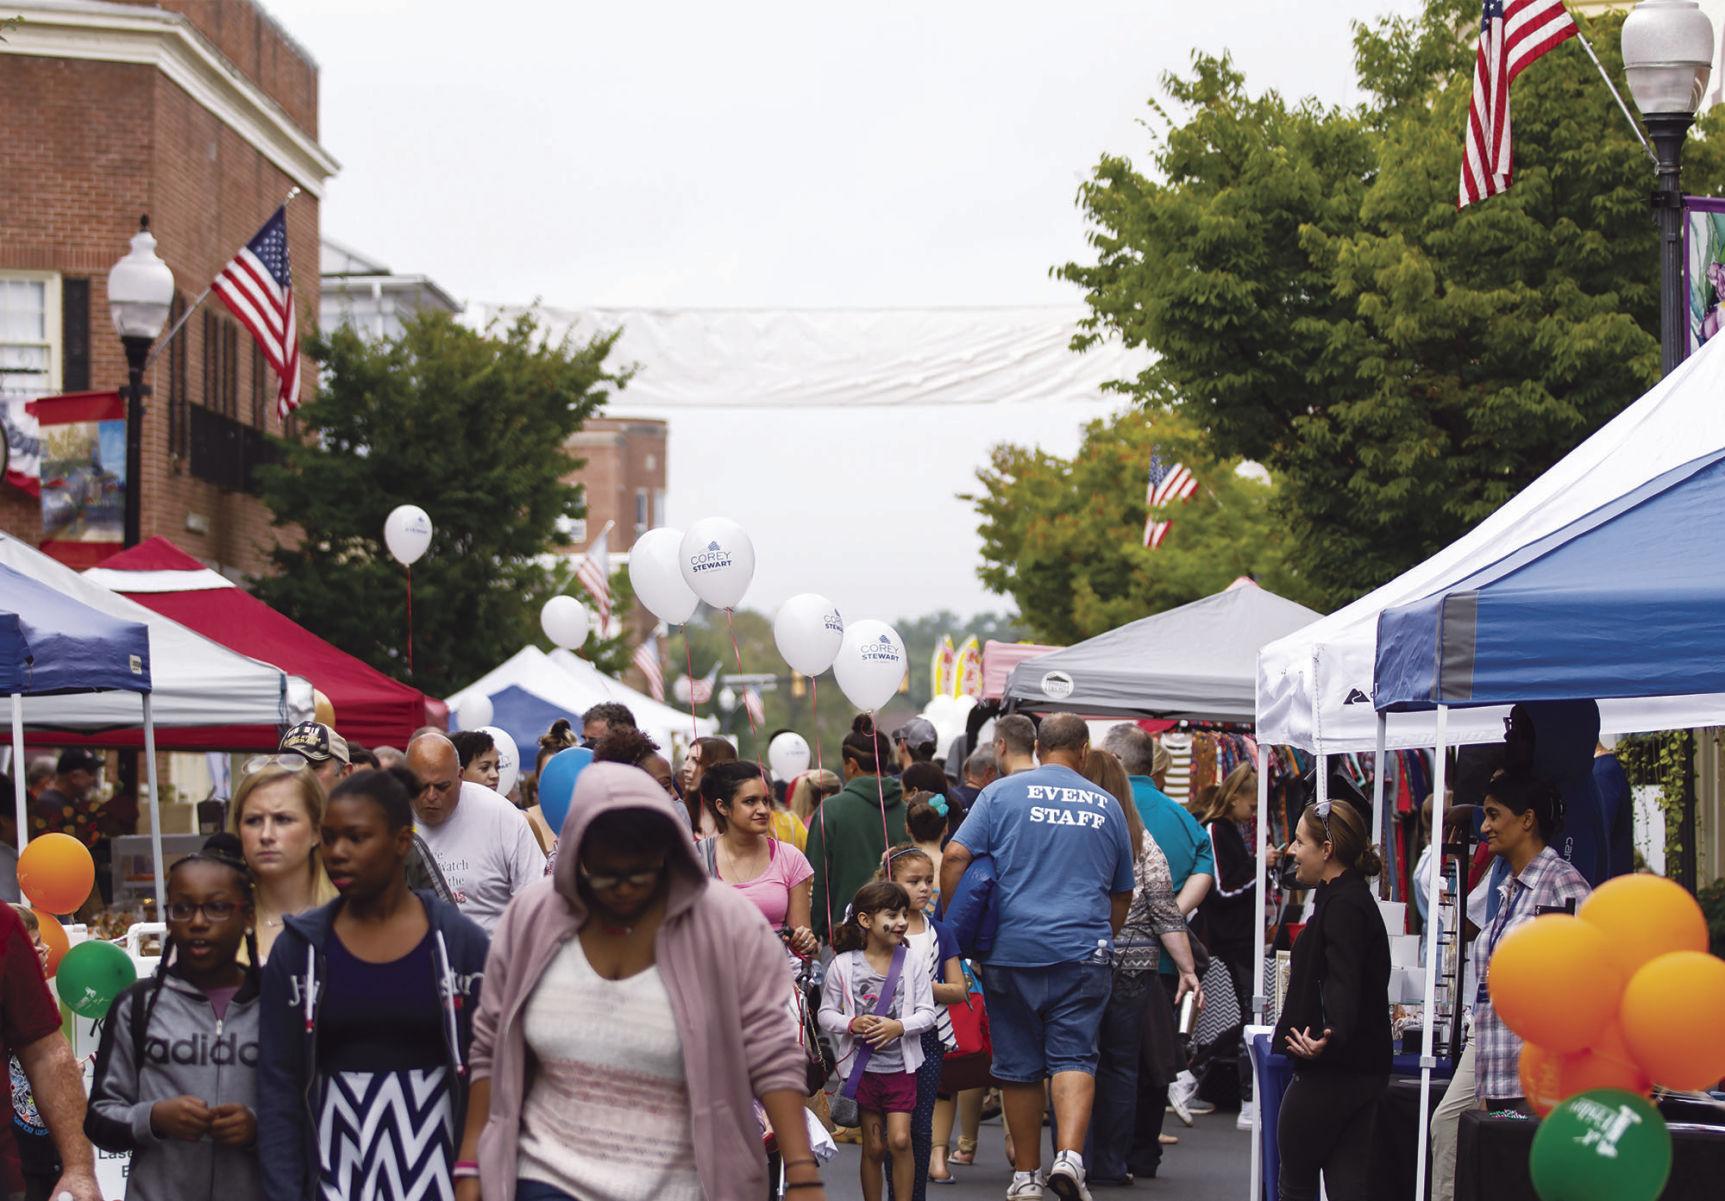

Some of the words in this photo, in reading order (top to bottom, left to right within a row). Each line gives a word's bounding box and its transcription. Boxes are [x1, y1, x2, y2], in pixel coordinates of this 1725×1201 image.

[690, 551, 732, 565] COREY
[692, 560, 733, 573] STEWART
[860, 643, 900, 654] COREY
[861, 653, 900, 662] STEWART
[1026, 784, 1108, 809] EVENT
[1029, 806, 1105, 830] STAFF
[144, 1032, 259, 1068] adida
